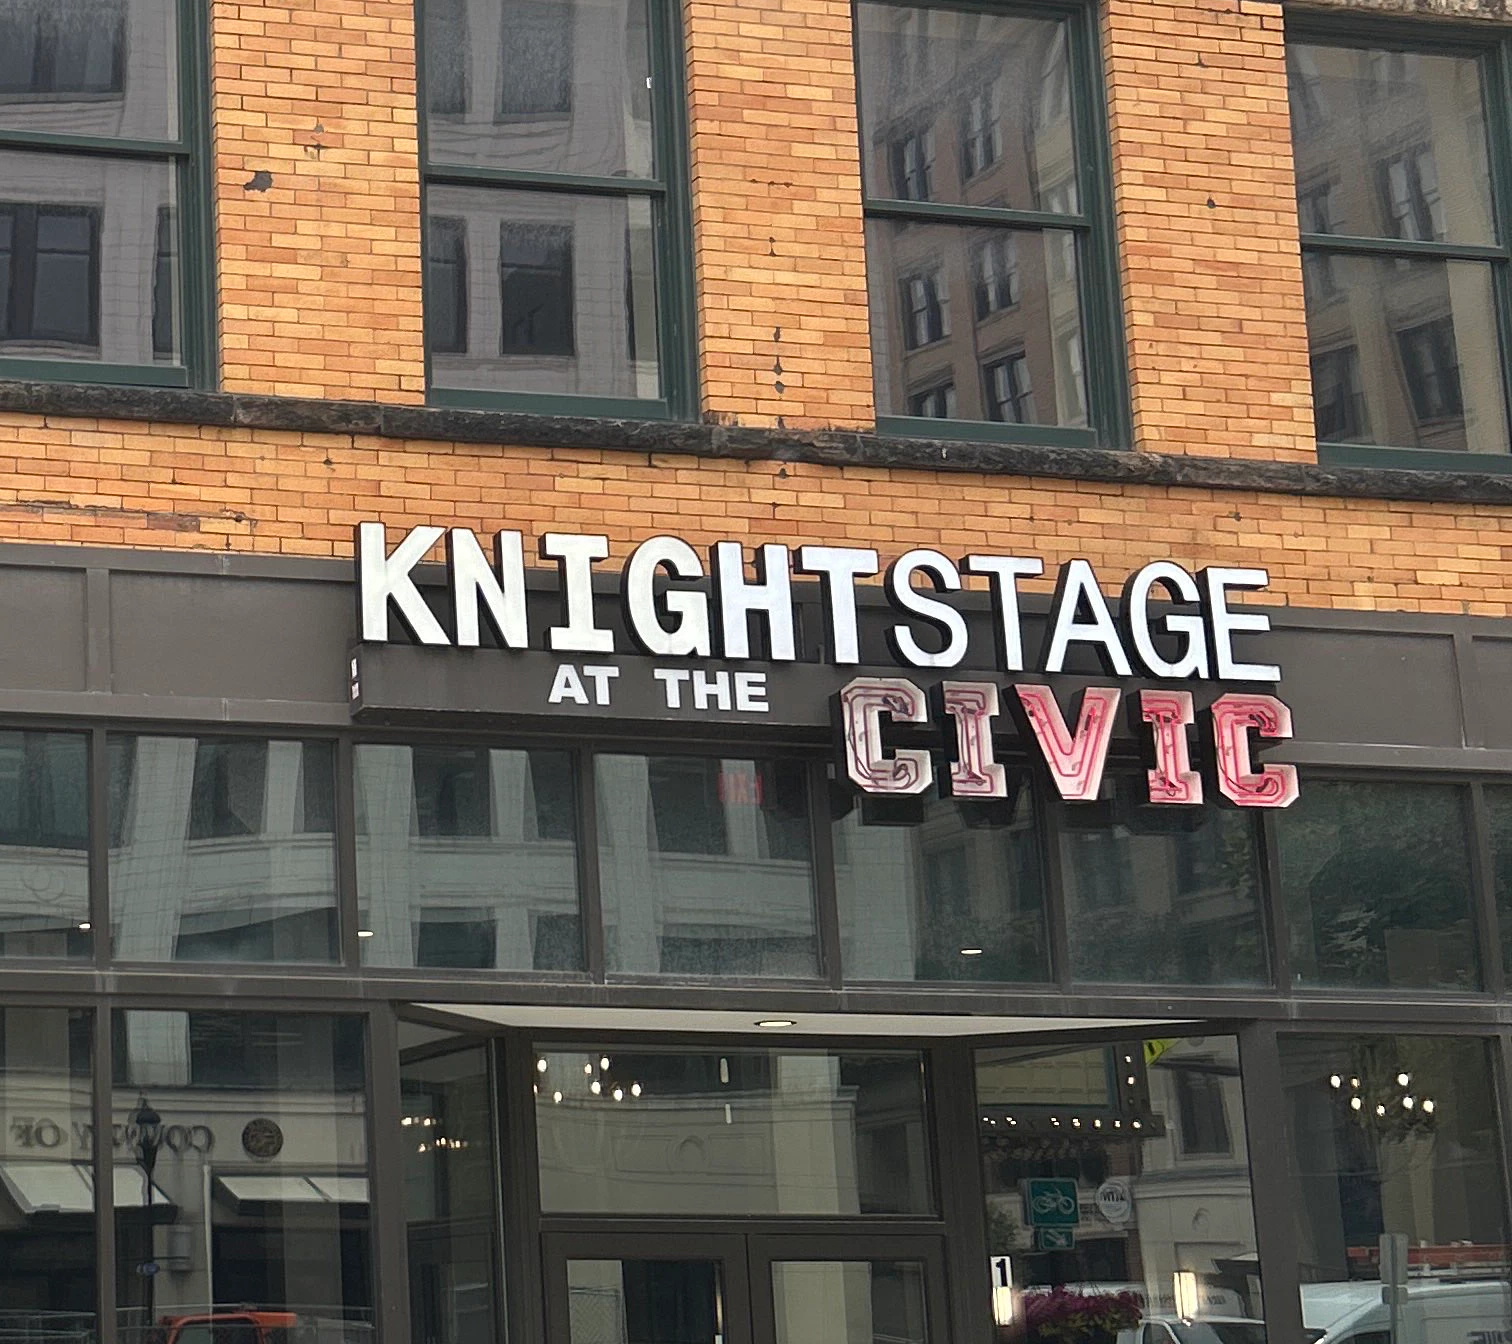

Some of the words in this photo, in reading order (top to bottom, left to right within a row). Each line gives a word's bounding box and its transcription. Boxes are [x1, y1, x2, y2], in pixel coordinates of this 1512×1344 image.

[354, 519, 1281, 682] KNIGHTSTAGE
[548, 664, 619, 706] AT
[663, 667, 770, 713] THE
[839, 676, 1300, 809] CIVIC
[995, 1258, 1008, 1285] 1
